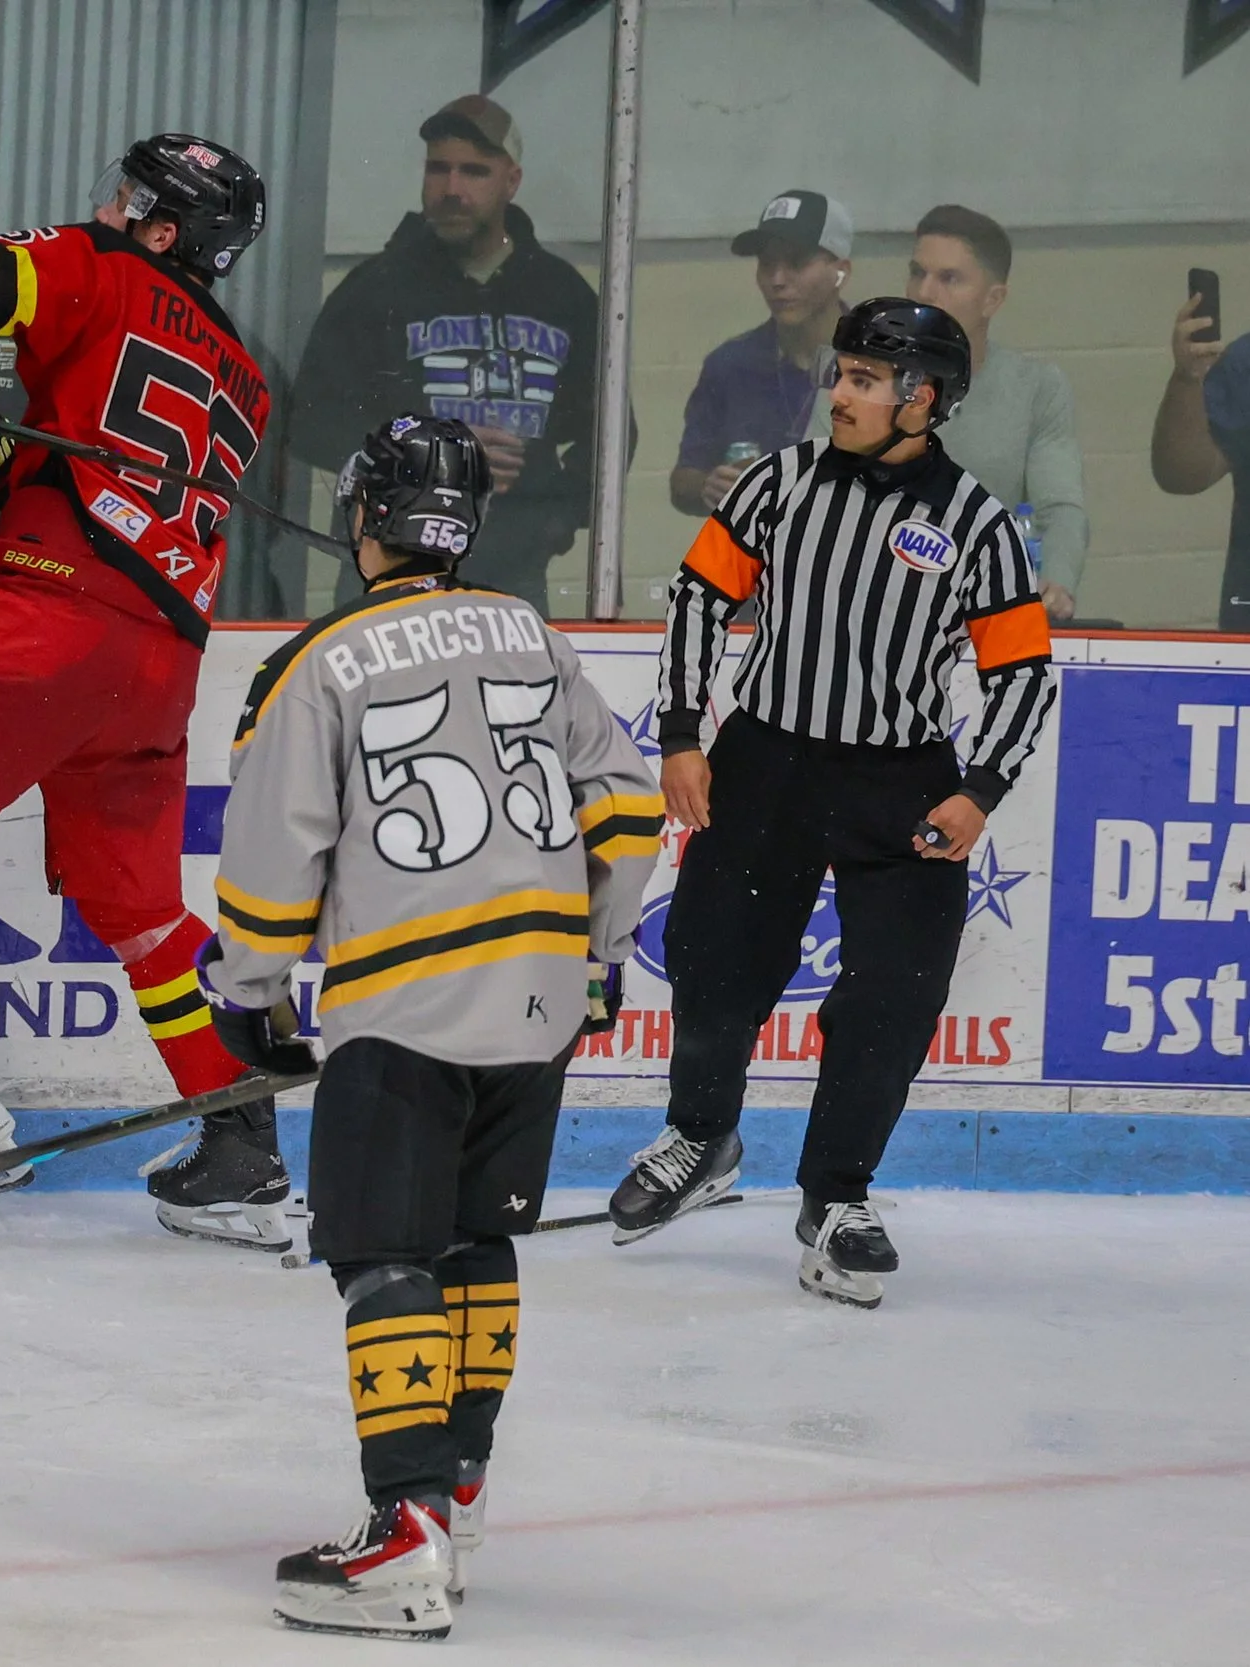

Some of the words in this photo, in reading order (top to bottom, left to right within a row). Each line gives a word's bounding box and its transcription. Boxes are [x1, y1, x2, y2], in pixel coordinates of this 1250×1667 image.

[96, 496, 147, 532] RTFC
[420, 519, 457, 548] 55
[3, 549, 76, 579] BAUER
[893, 526, 948, 568] NAHL
[324, 606, 547, 692] BJERGSTAD
[359, 675, 579, 873] 55
